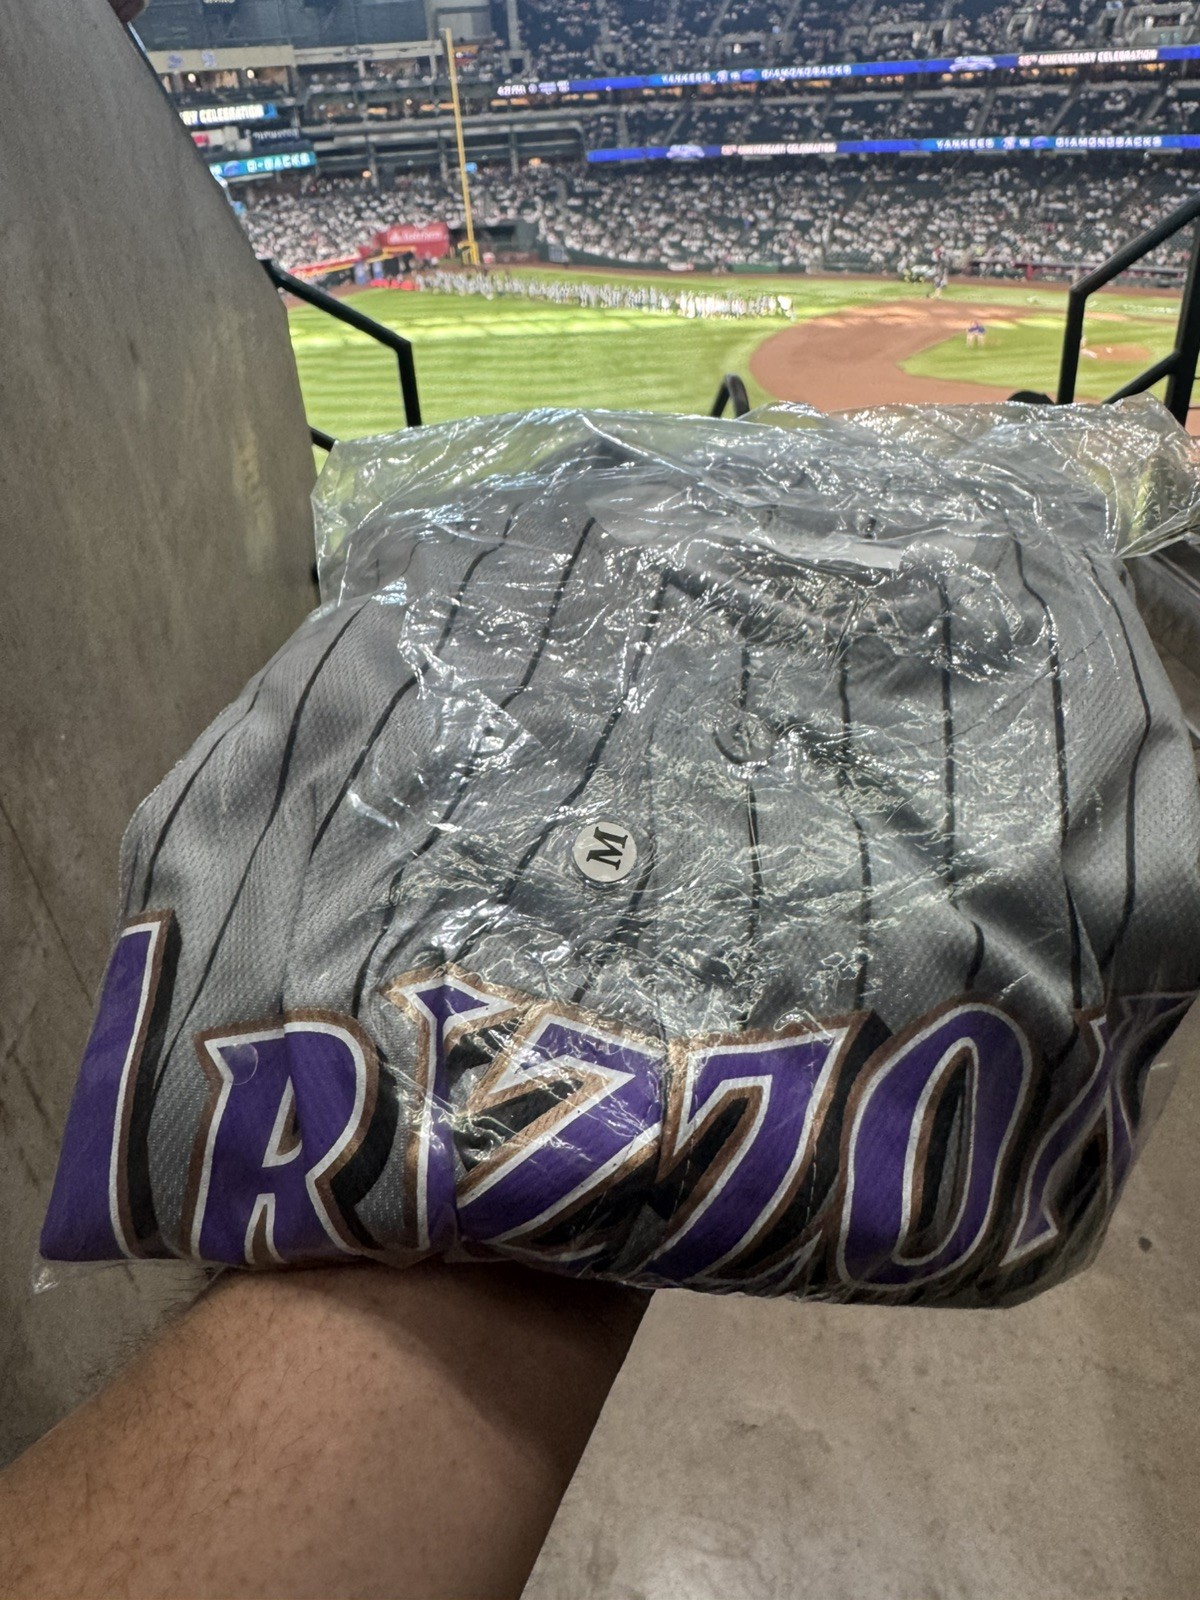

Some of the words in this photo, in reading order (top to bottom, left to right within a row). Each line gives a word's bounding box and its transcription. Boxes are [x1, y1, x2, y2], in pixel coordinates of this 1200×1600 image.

[1097, 49, 1159, 63] CELEBRATION
[199, 104, 265, 124] CELEBRATION
[936, 139, 995, 149] YANKEES
[1055, 137, 1162, 148] DIAMONDBACKS
[246, 152, 311, 173] D-BACKS
[586, 826, 628, 871] M
